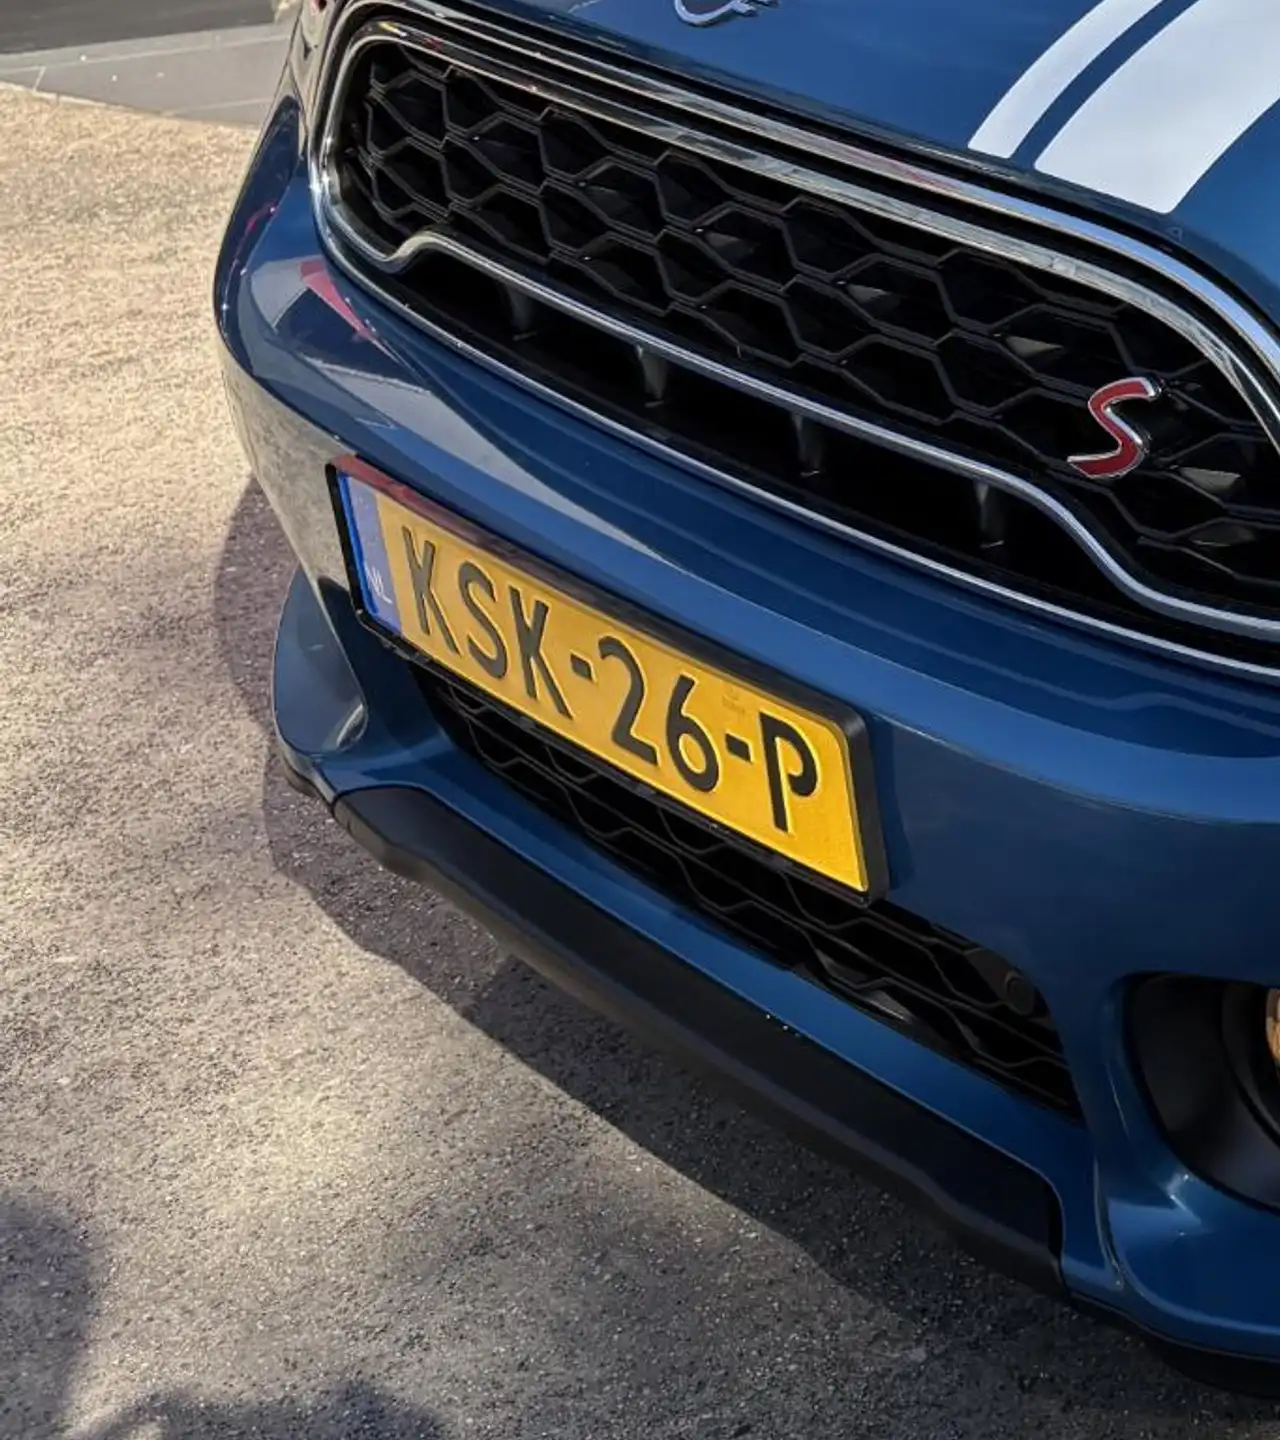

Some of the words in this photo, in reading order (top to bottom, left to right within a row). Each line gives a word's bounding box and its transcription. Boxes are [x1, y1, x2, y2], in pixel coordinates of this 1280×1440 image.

[1066, 375, 1162, 479] S
[366, 566, 394, 606] NL
[401, 525, 821, 835] KSK-26-P
